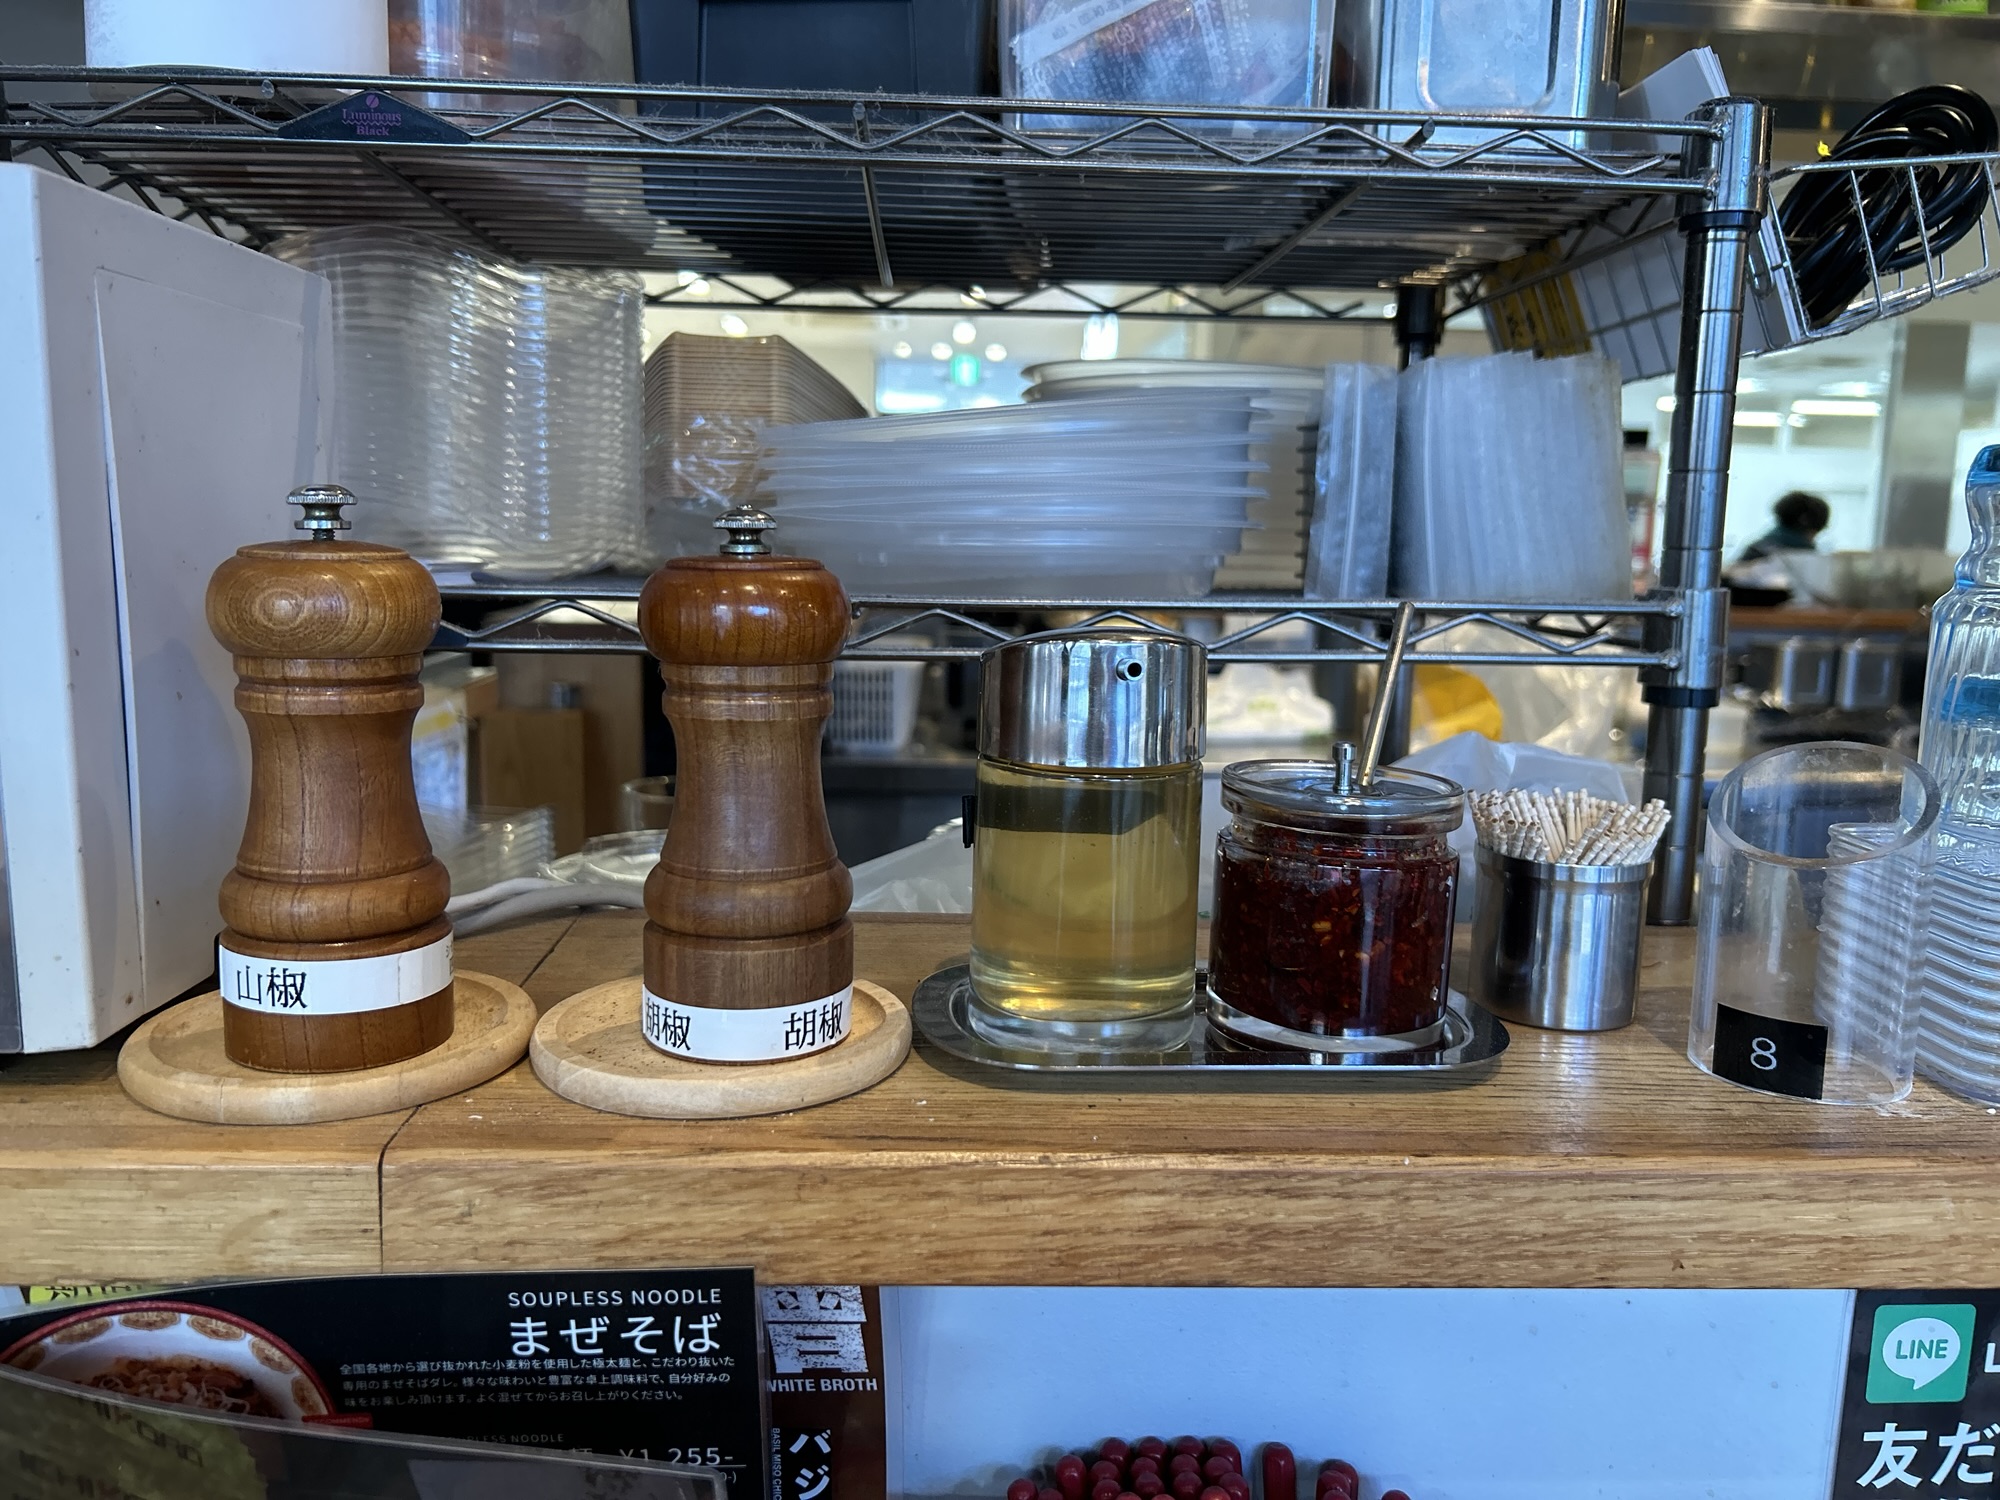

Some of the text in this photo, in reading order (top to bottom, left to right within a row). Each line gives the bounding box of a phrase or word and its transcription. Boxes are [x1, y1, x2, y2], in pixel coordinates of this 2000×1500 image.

[342, 109, 401, 121] Luminous
[356, 126, 390, 136] Black
[236, 965, 308, 1009] 山椒
[645, 997, 843, 1051] 胡椒 胡椒
[1750, 1037, 1777, 1070] 8
[508, 1288, 722, 1307] SOUPLESS NOODLE
[510, 1312, 721, 1356] まぜそば
[1895, 1339, 1948, 1359] LINE
[820, 1378, 878, 1392] BROTH
[511, 1433, 565, 1443] NOODLE
[772, 1427, 781, 1452] BASIL
[773, 1454, 782, 1477] MISO
[789, 1429, 831, 1500] バジ
[1856, 1422, 2000, 1489] 友だ
